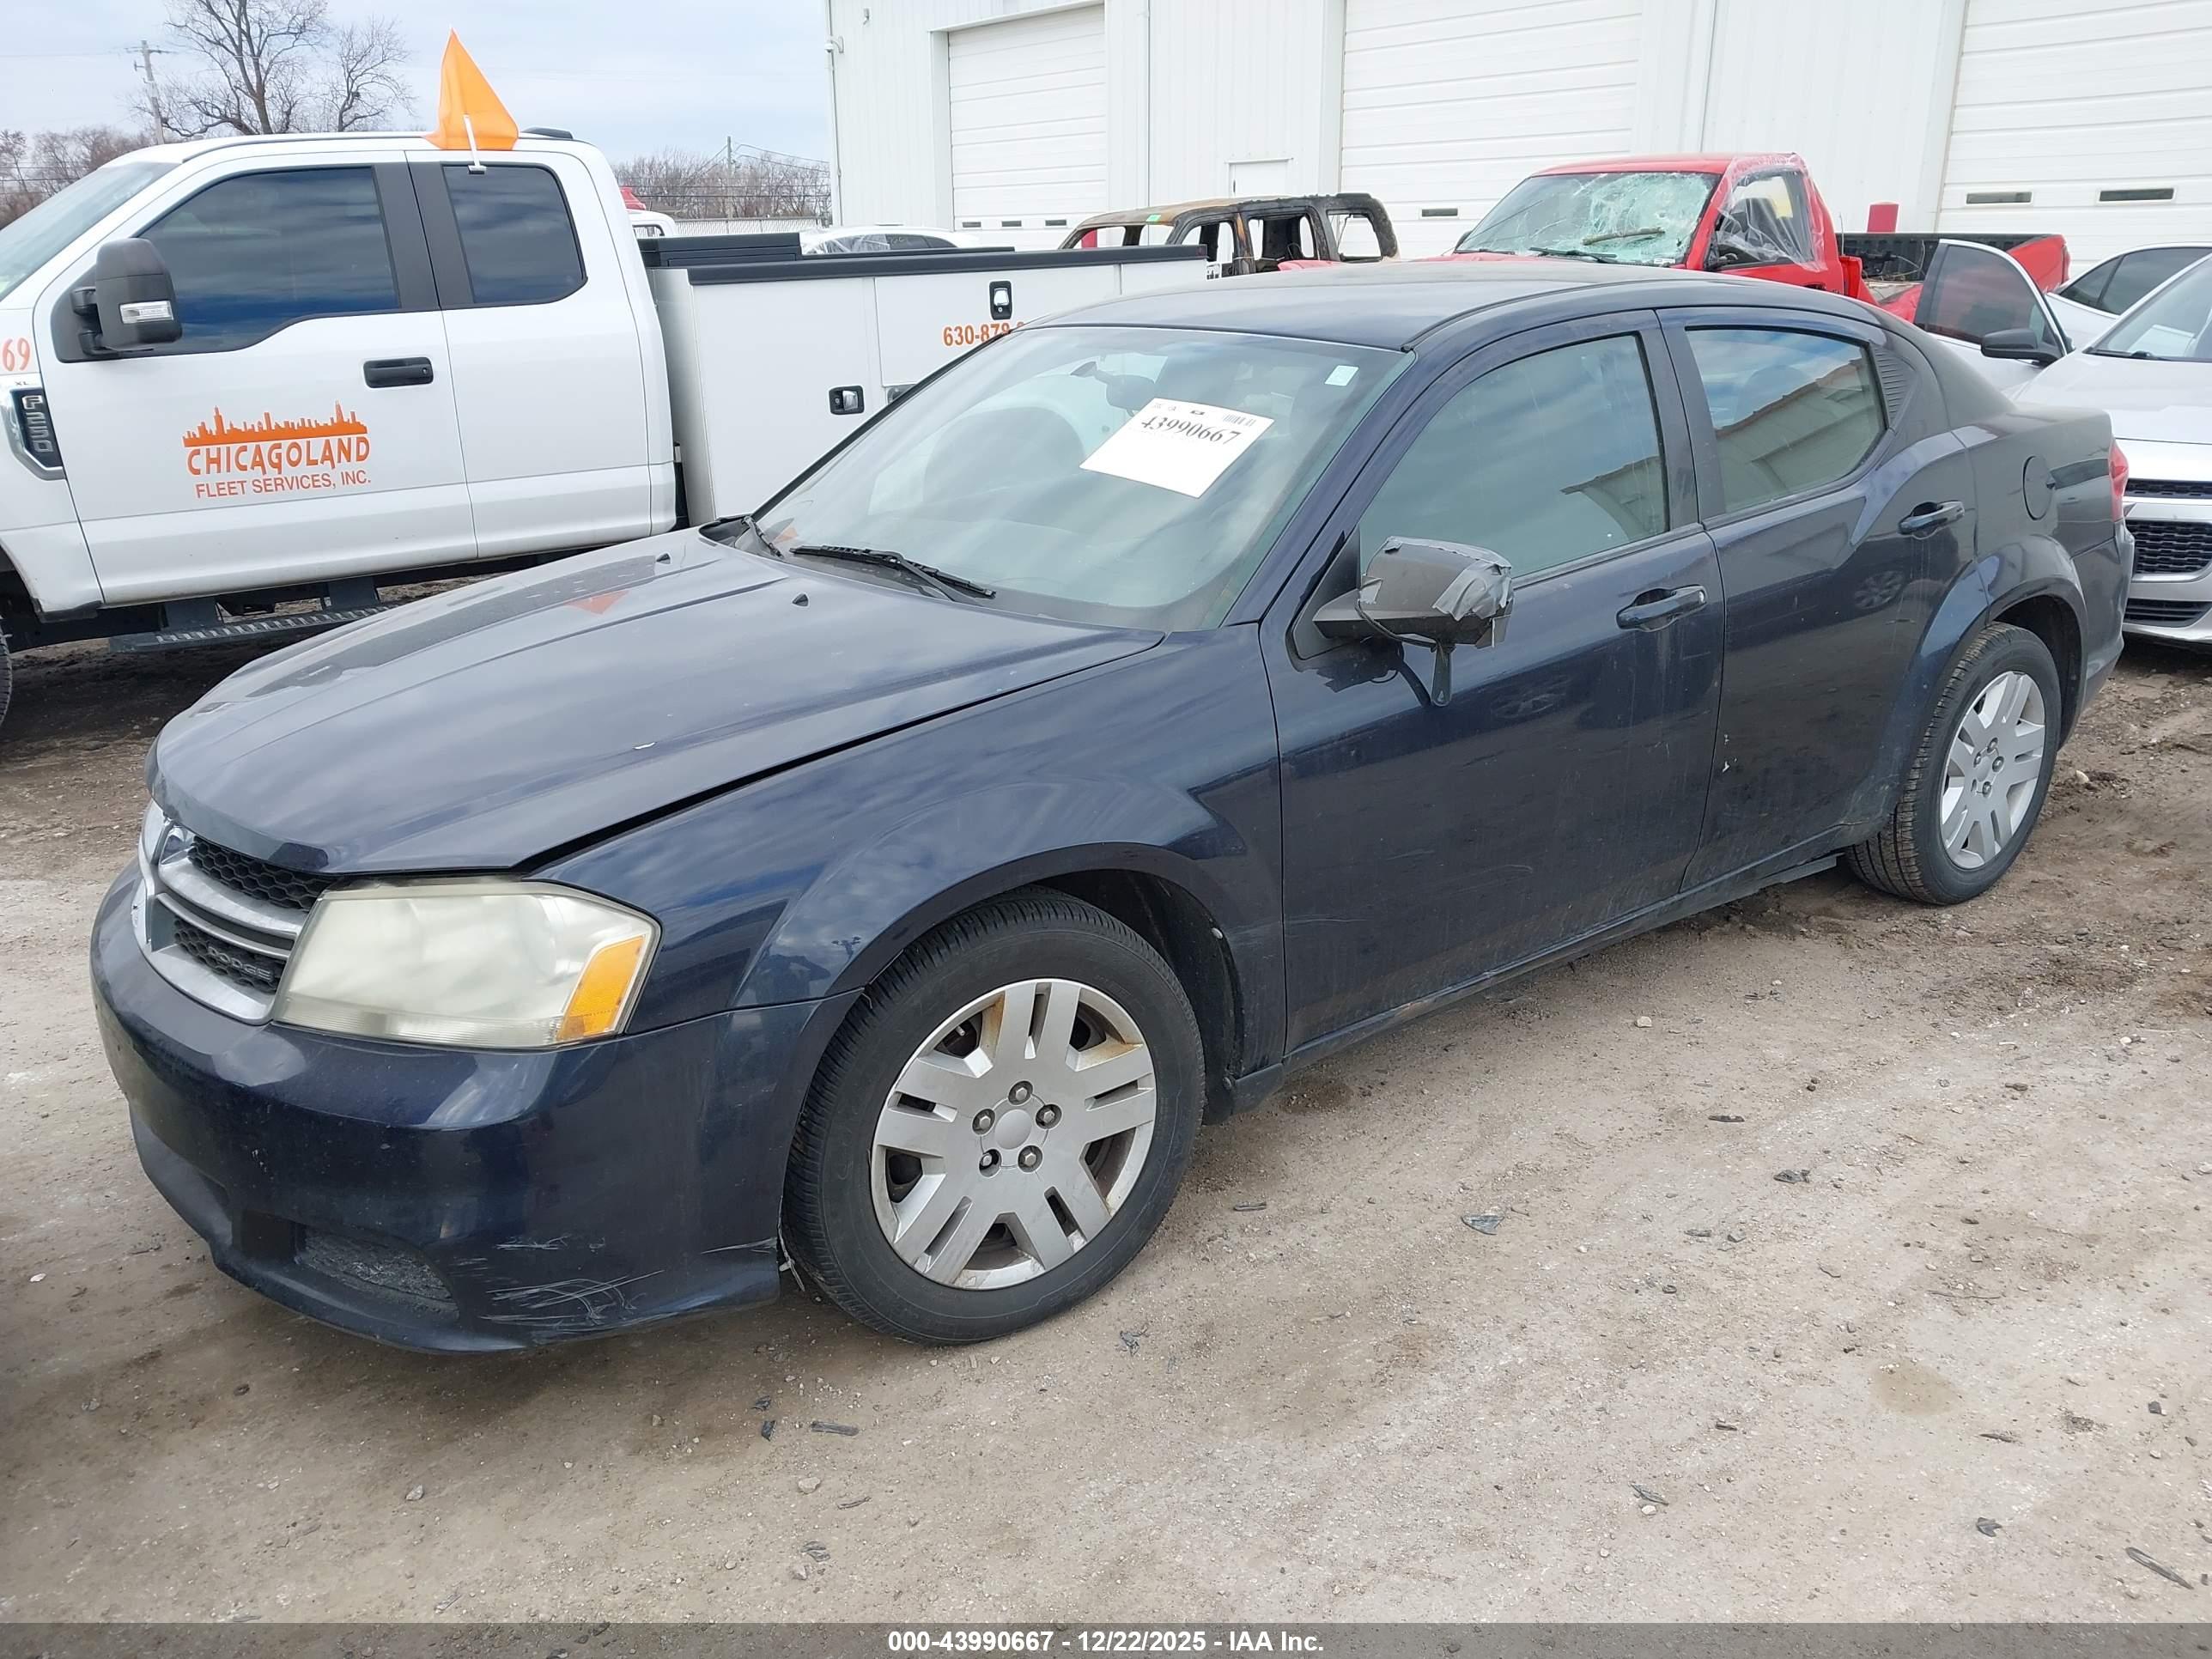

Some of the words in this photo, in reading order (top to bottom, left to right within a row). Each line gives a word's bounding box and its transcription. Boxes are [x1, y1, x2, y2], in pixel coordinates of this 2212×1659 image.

[943, 321, 1024, 346] 630-878
[3, 337, 30, 371] 69
[1141, 415, 1242, 445] 43990667
[187, 436, 370, 475] CHICAGOLAND
[196, 481, 246, 498] FLEET
[252, 475, 336, 494] SERVICES,
[341, 470, 371, 485] INC.
[207, 946, 271, 981] DODGE
